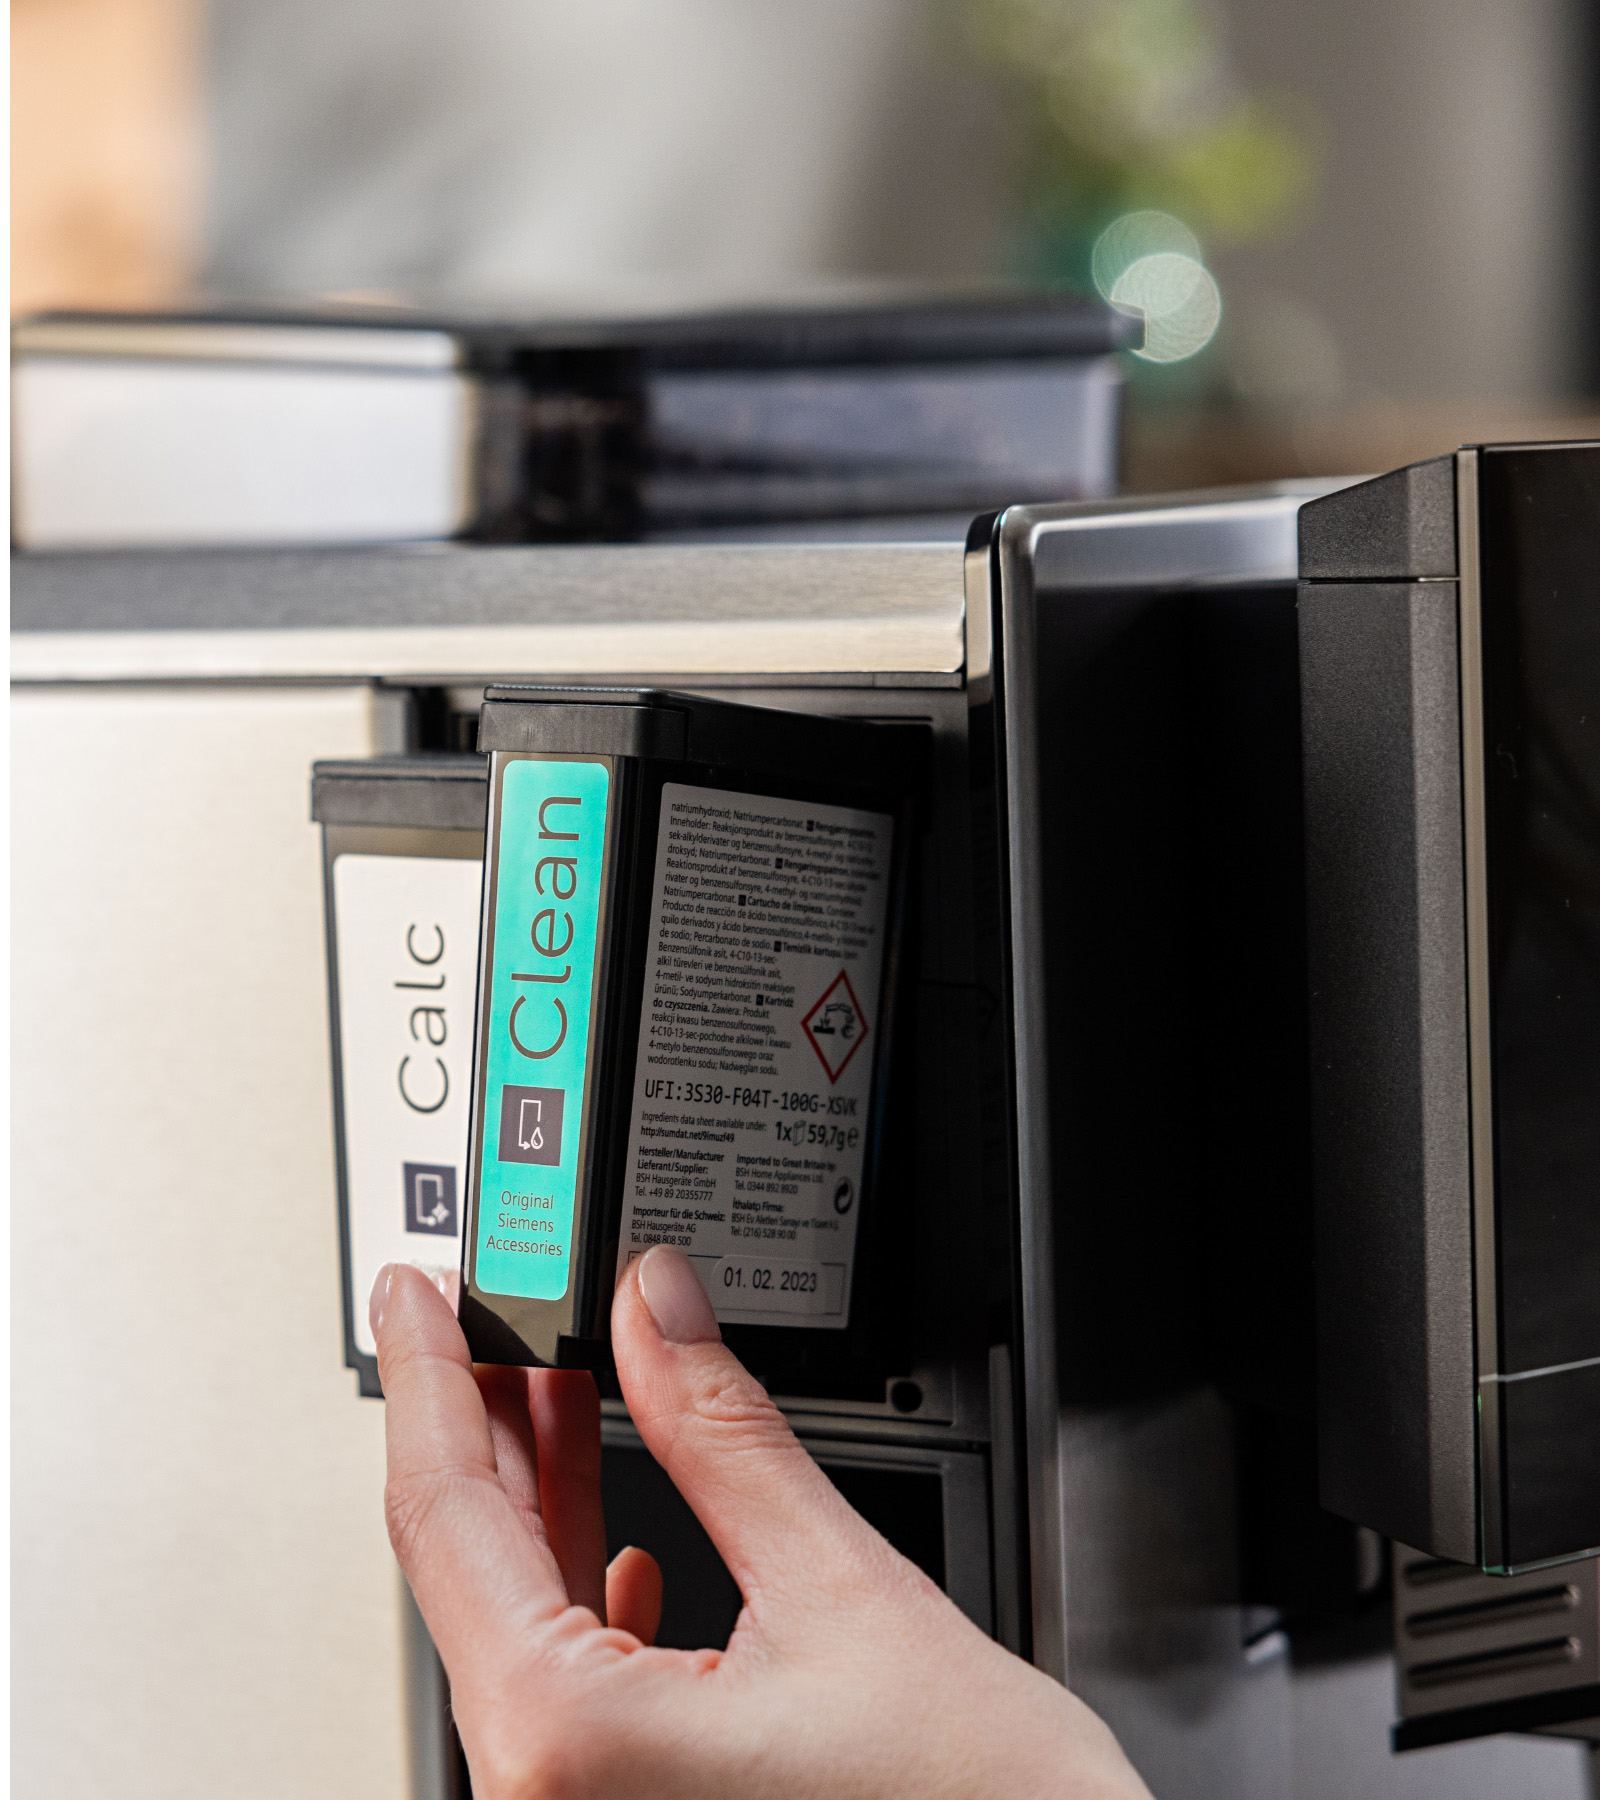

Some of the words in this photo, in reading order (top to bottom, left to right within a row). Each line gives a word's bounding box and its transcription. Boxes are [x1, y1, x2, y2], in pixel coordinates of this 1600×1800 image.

[509, 796, 581, 1060] Clean
[659, 927, 669, 937] de
[670, 930, 691, 941] sodio;
[694, 931, 740, 945] Percarbonato
[741, 938, 750, 947] de
[752, 940, 770, 949] sodio.
[394, 924, 449, 1113] Calc
[642, 1111, 679, 1122] Ingredients
[680, 1115, 695, 1125] data
[696, 1116, 714, 1126] sheet
[716, 1119, 744, 1129] available
[746, 1121, 766, 1130] under:
[639, 1146, 724, 1161] Hersteller/Manufacturer
[637, 1159, 708, 1174] Lieferant/Supplier:
[636, 1172, 650, 1182] BSH
[652, 1174, 692, 1187] Hausgeräte
[693, 1177, 716, 1187] GmbH
[501, 1190, 553, 1210] Original
[635, 1185, 647, 1196] Tel.
[649, 1187, 663, 1197] +49
[664, 1188, 674, 1198] 89
[675, 1189, 713, 1200] 20355777
[497, 1211, 554, 1232] Siemens
[633, 1206, 669, 1218] Importeur
[670, 1208, 681, 1218] für
[681, 1209, 693, 1219] die
[694, 1210, 725, 1221] Schweiz:
[631, 1219, 645, 1229] BSH
[646, 1221, 684, 1233] Hausgeräte
[685, 1223, 696, 1233] AG
[486, 1233, 563, 1256] Accessories
[630, 1232, 642, 1242] Tel.
[643, 1233, 661, 1245] 0848
[661, 1234, 676, 1245] 808
[677, 1235, 691, 1246] 500
[724, 1266, 745, 1287] 01.
[752, 1269, 774, 1289] 02.
[780, 1271, 816, 1292] 2023
